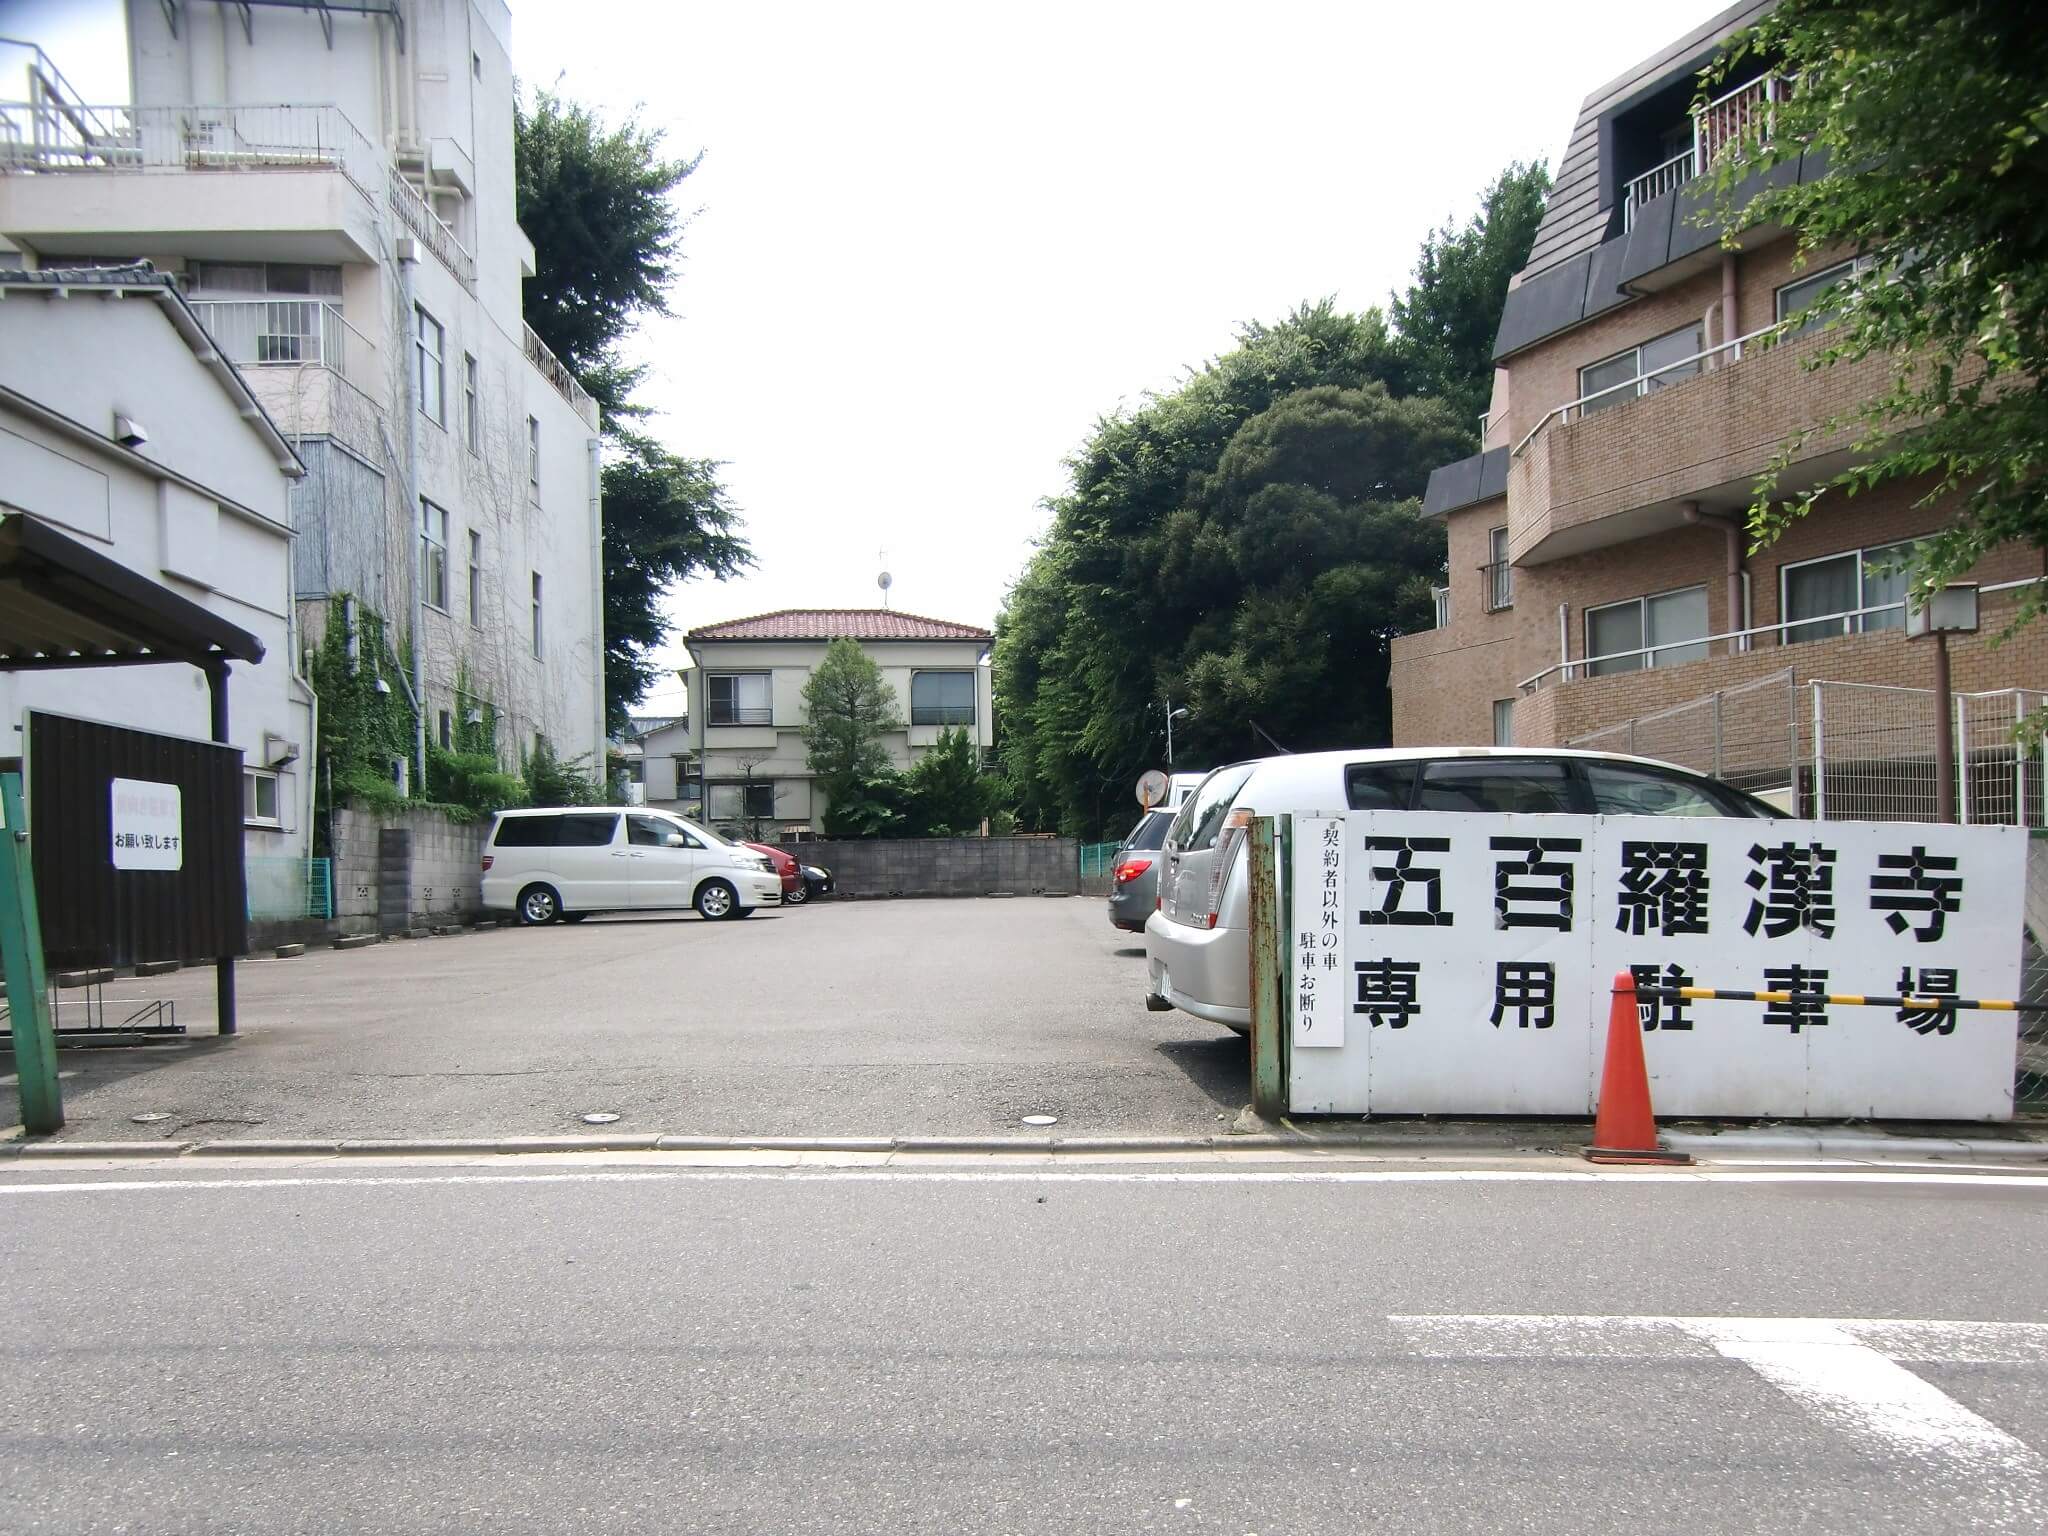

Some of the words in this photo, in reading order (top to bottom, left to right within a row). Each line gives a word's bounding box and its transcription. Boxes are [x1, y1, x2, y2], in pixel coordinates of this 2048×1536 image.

[115, 832, 180, 851] お願い致します
[1359, 835, 1964, 943] 五百羅漢寺
[1322, 828, 1340, 971] 契約者以外の車
[1299, 932, 1317, 1032] 駐車お断り
[1353, 957, 1961, 1035] 専用駐車場
